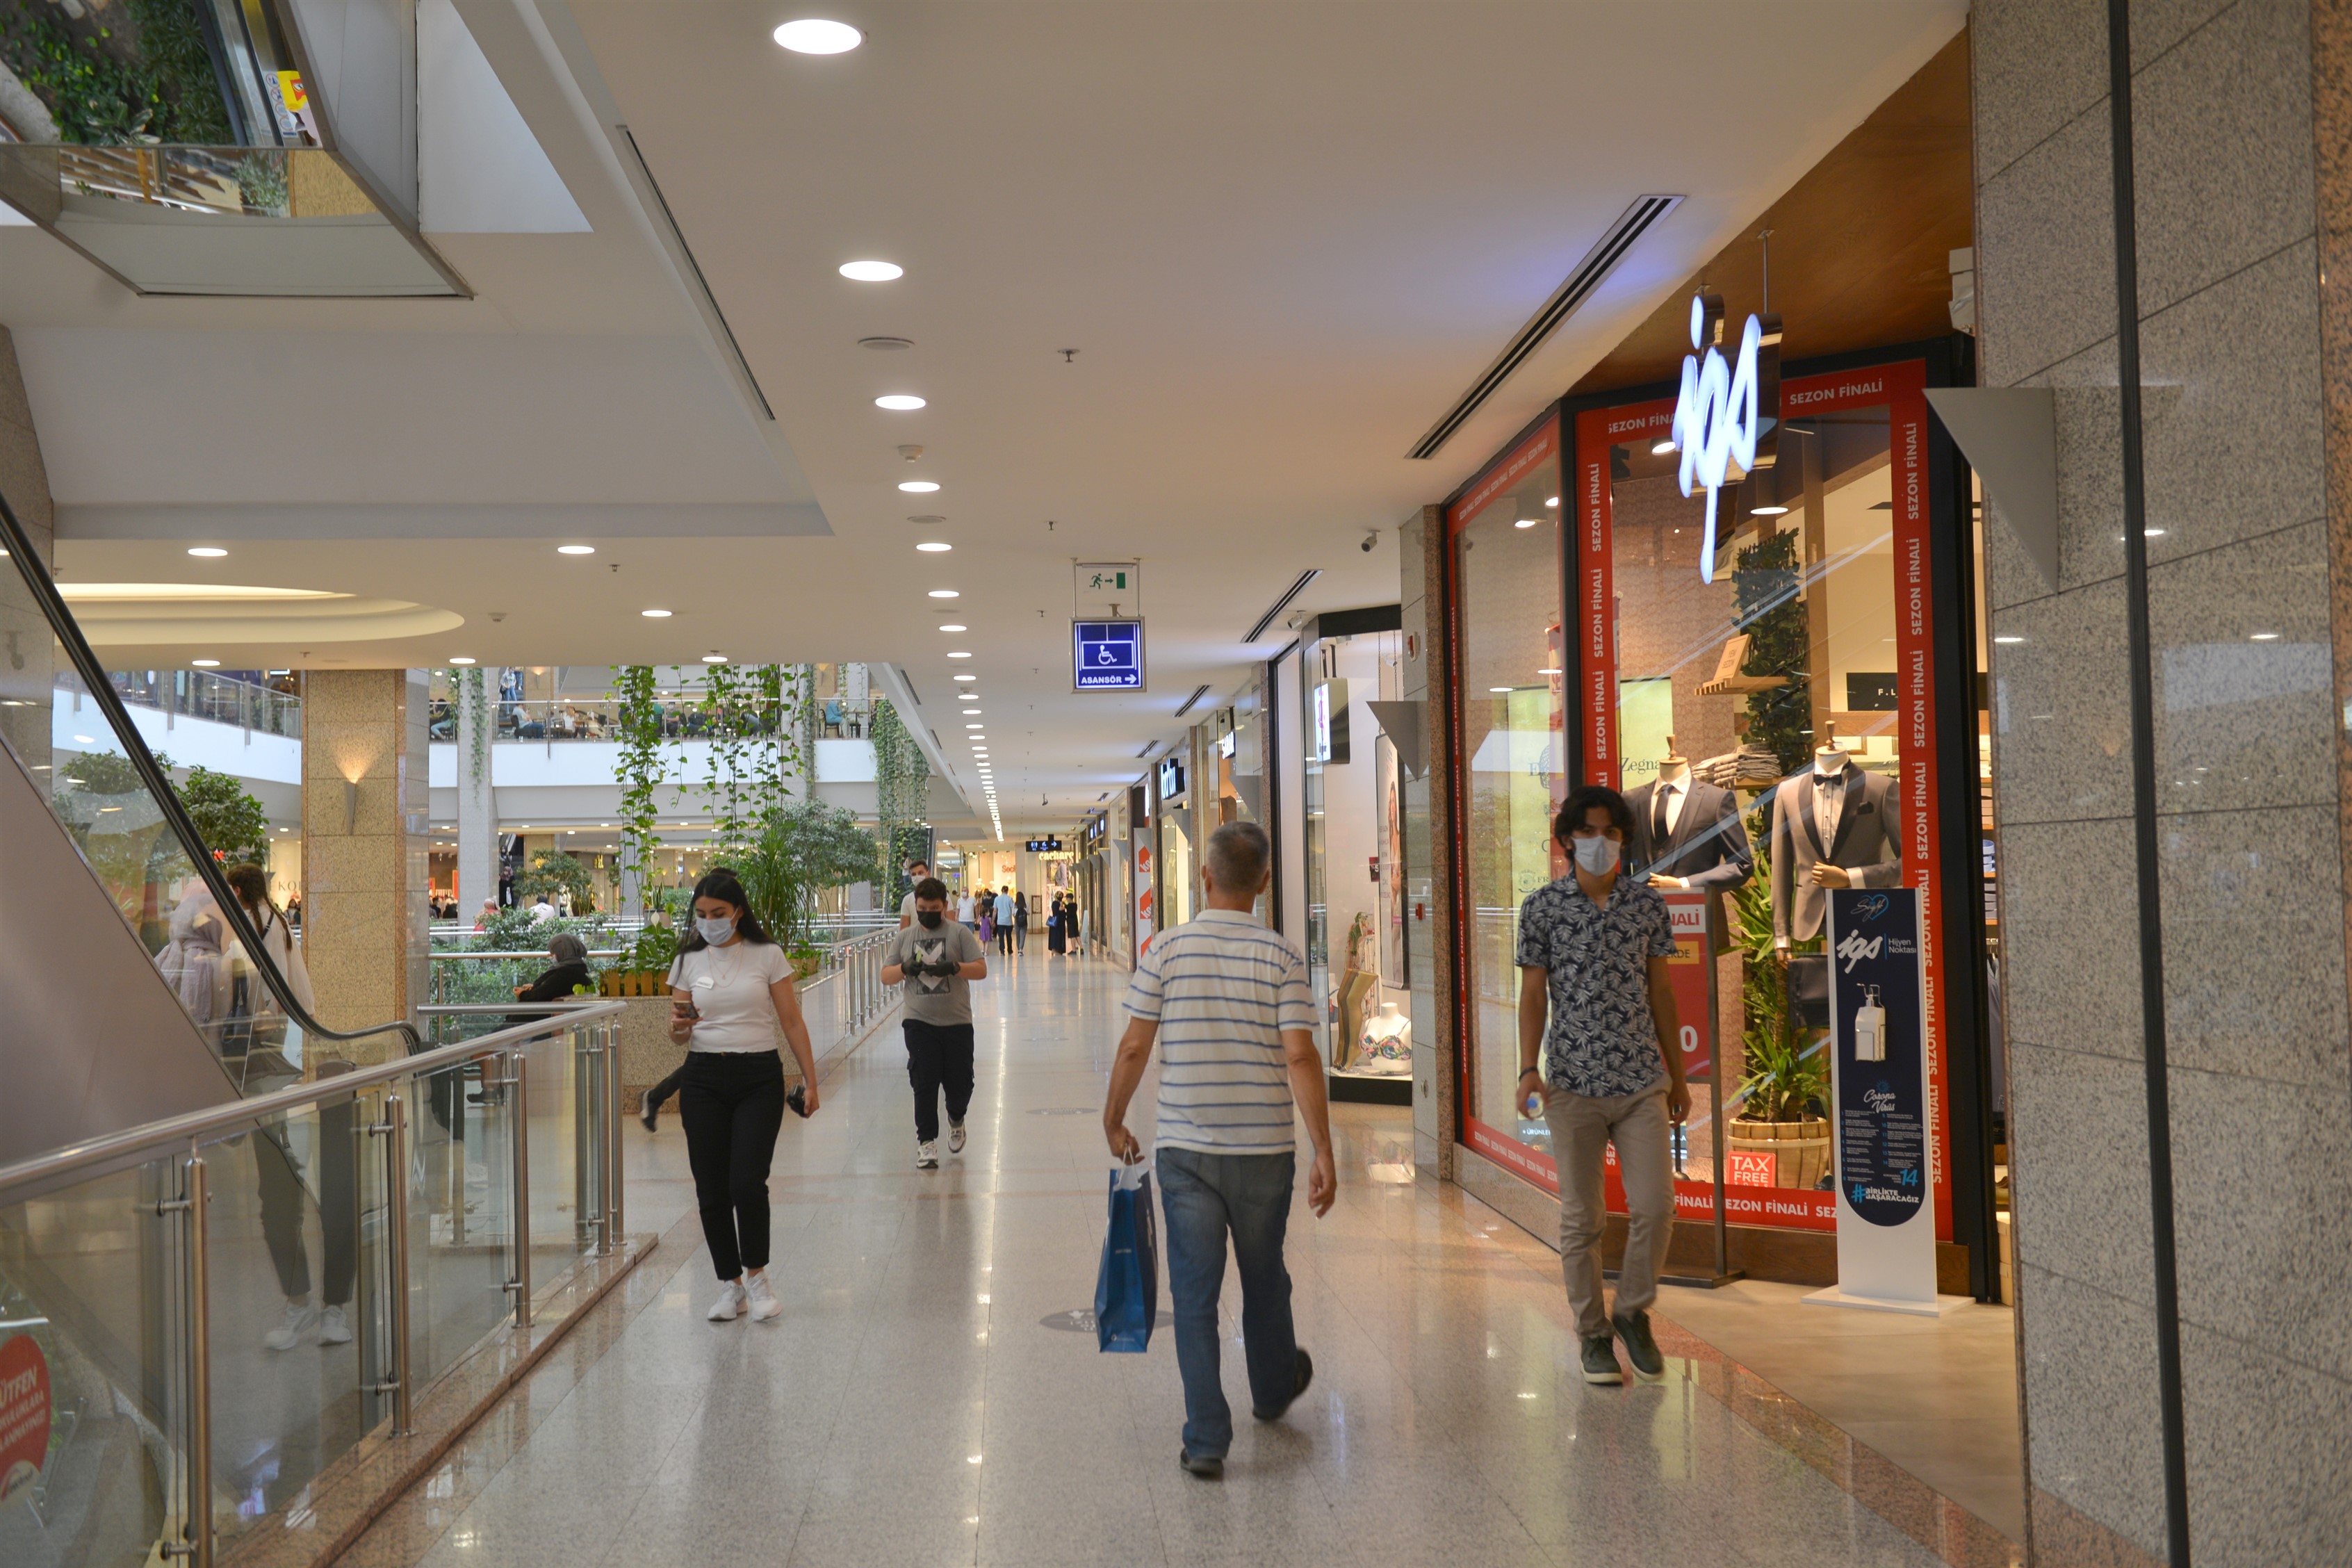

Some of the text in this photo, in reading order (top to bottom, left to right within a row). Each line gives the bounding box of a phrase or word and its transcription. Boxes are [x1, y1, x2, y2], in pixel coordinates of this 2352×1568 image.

[1790, 377, 1883, 405] SEZON FİNALİ
[1904, 422, 1918, 519] SEZON FİNALİ
[1589, 464, 1602, 551] SEZON FİNALİ
[1906, 538, 1922, 635] SEZON FİNALİ
[1591, 569, 1603, 658] SEZON FİNALİ
[1081, 675, 1122, 684] ASANSÖR
[1592, 671, 1605, 713] FİNALİ
[1909, 650, 1925, 747] SEZON FİNALİ
[1596, 716, 1607, 760] SEZON
[1912, 762, 1928, 860] SEZON FİNALİ
[278, 881, 301, 891] KO
[1888, 938, 1911, 947] Hijyen
[1927, 1026, 1938, 1076] SEZON
[1864, 1089, 1896, 1103] Corona
[1606, 1142, 1616, 1166] SEZ
[1731, 1155, 1772, 1173] TAX
[1932, 1134, 1943, 1184] SEZON
[1734, 1170, 1769, 1183] FREE
[1900, 1169, 1918, 1186] 14
[1674, 1193, 1713, 1209] FİNALİ
[1724, 1198, 1808, 1216] EZON FİNALİ
[1815, 1205, 1837, 1218] SEZ
[0, 1364, 37, 1408] ÜTFEN
